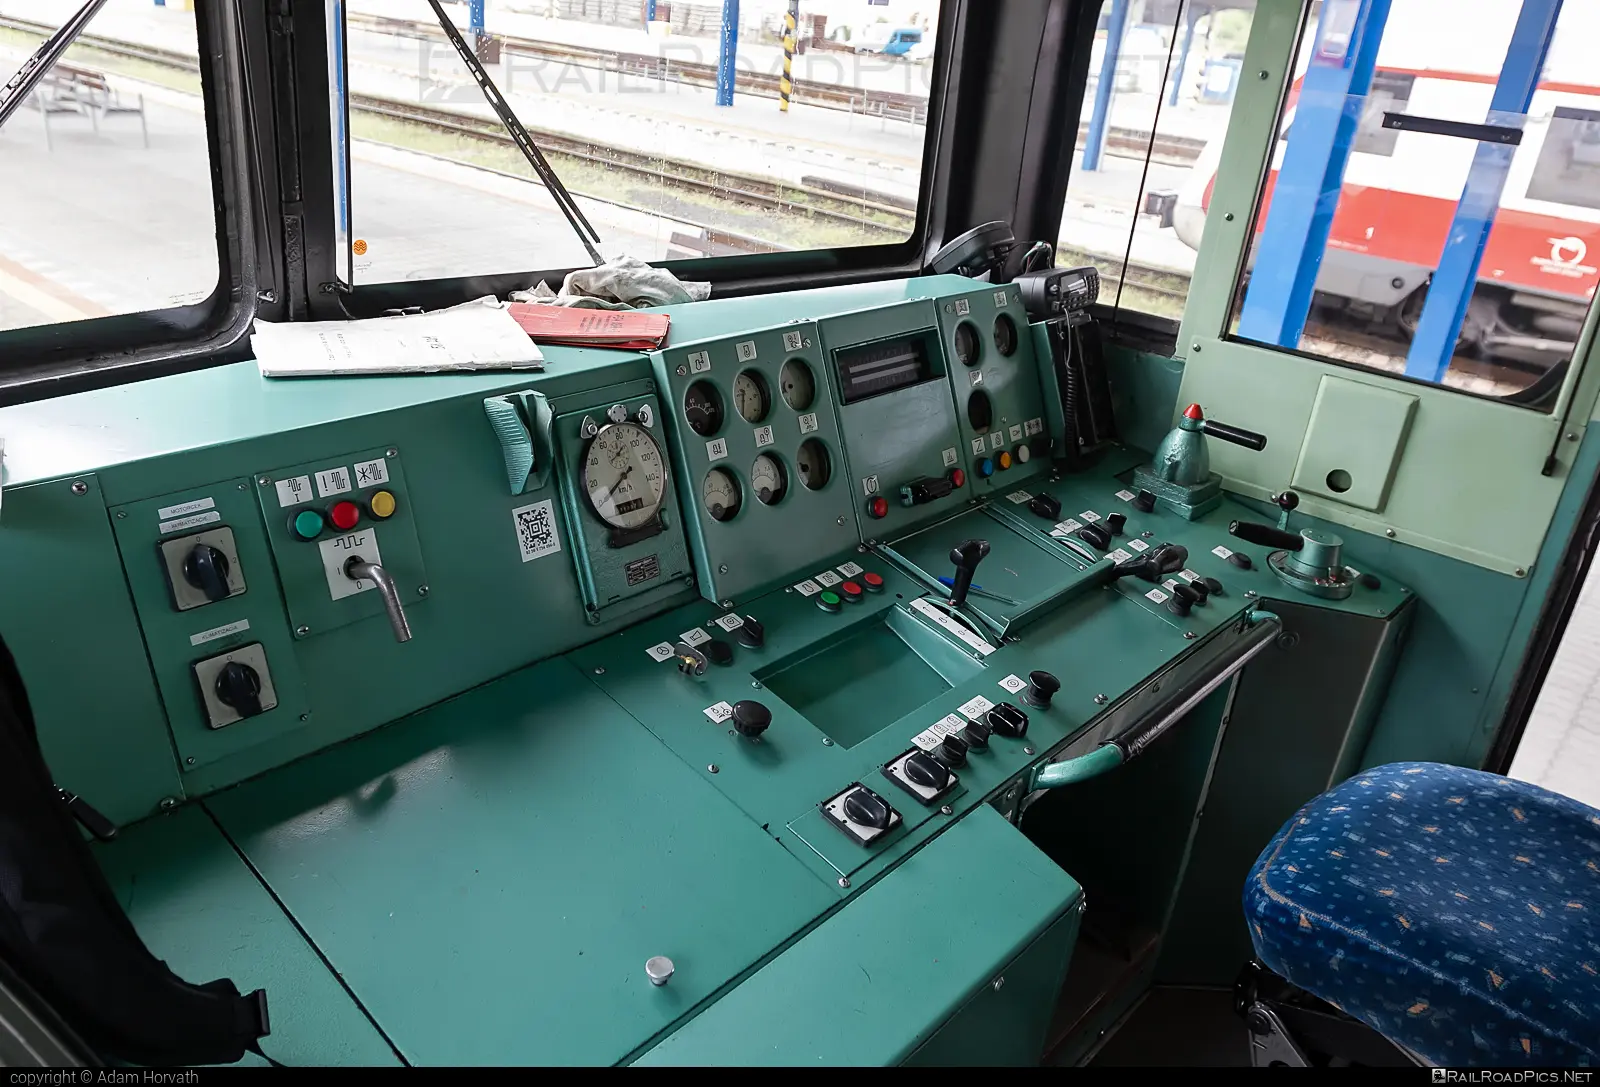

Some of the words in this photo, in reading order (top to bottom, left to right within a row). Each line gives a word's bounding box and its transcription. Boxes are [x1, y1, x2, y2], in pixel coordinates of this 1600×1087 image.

[615, 431, 624, 440] 80
[599, 441, 608, 450] 60
[629, 439, 640, 448] 100
[590, 457, 599, 466] 40
[641, 453, 651, 461] 120
[645, 473, 656, 482] 140
[590, 479, 598, 488] 20
[618, 483, 633, 493] km/h
[232, 556, 237, 564] 2
[356, 580, 363, 590] 0
